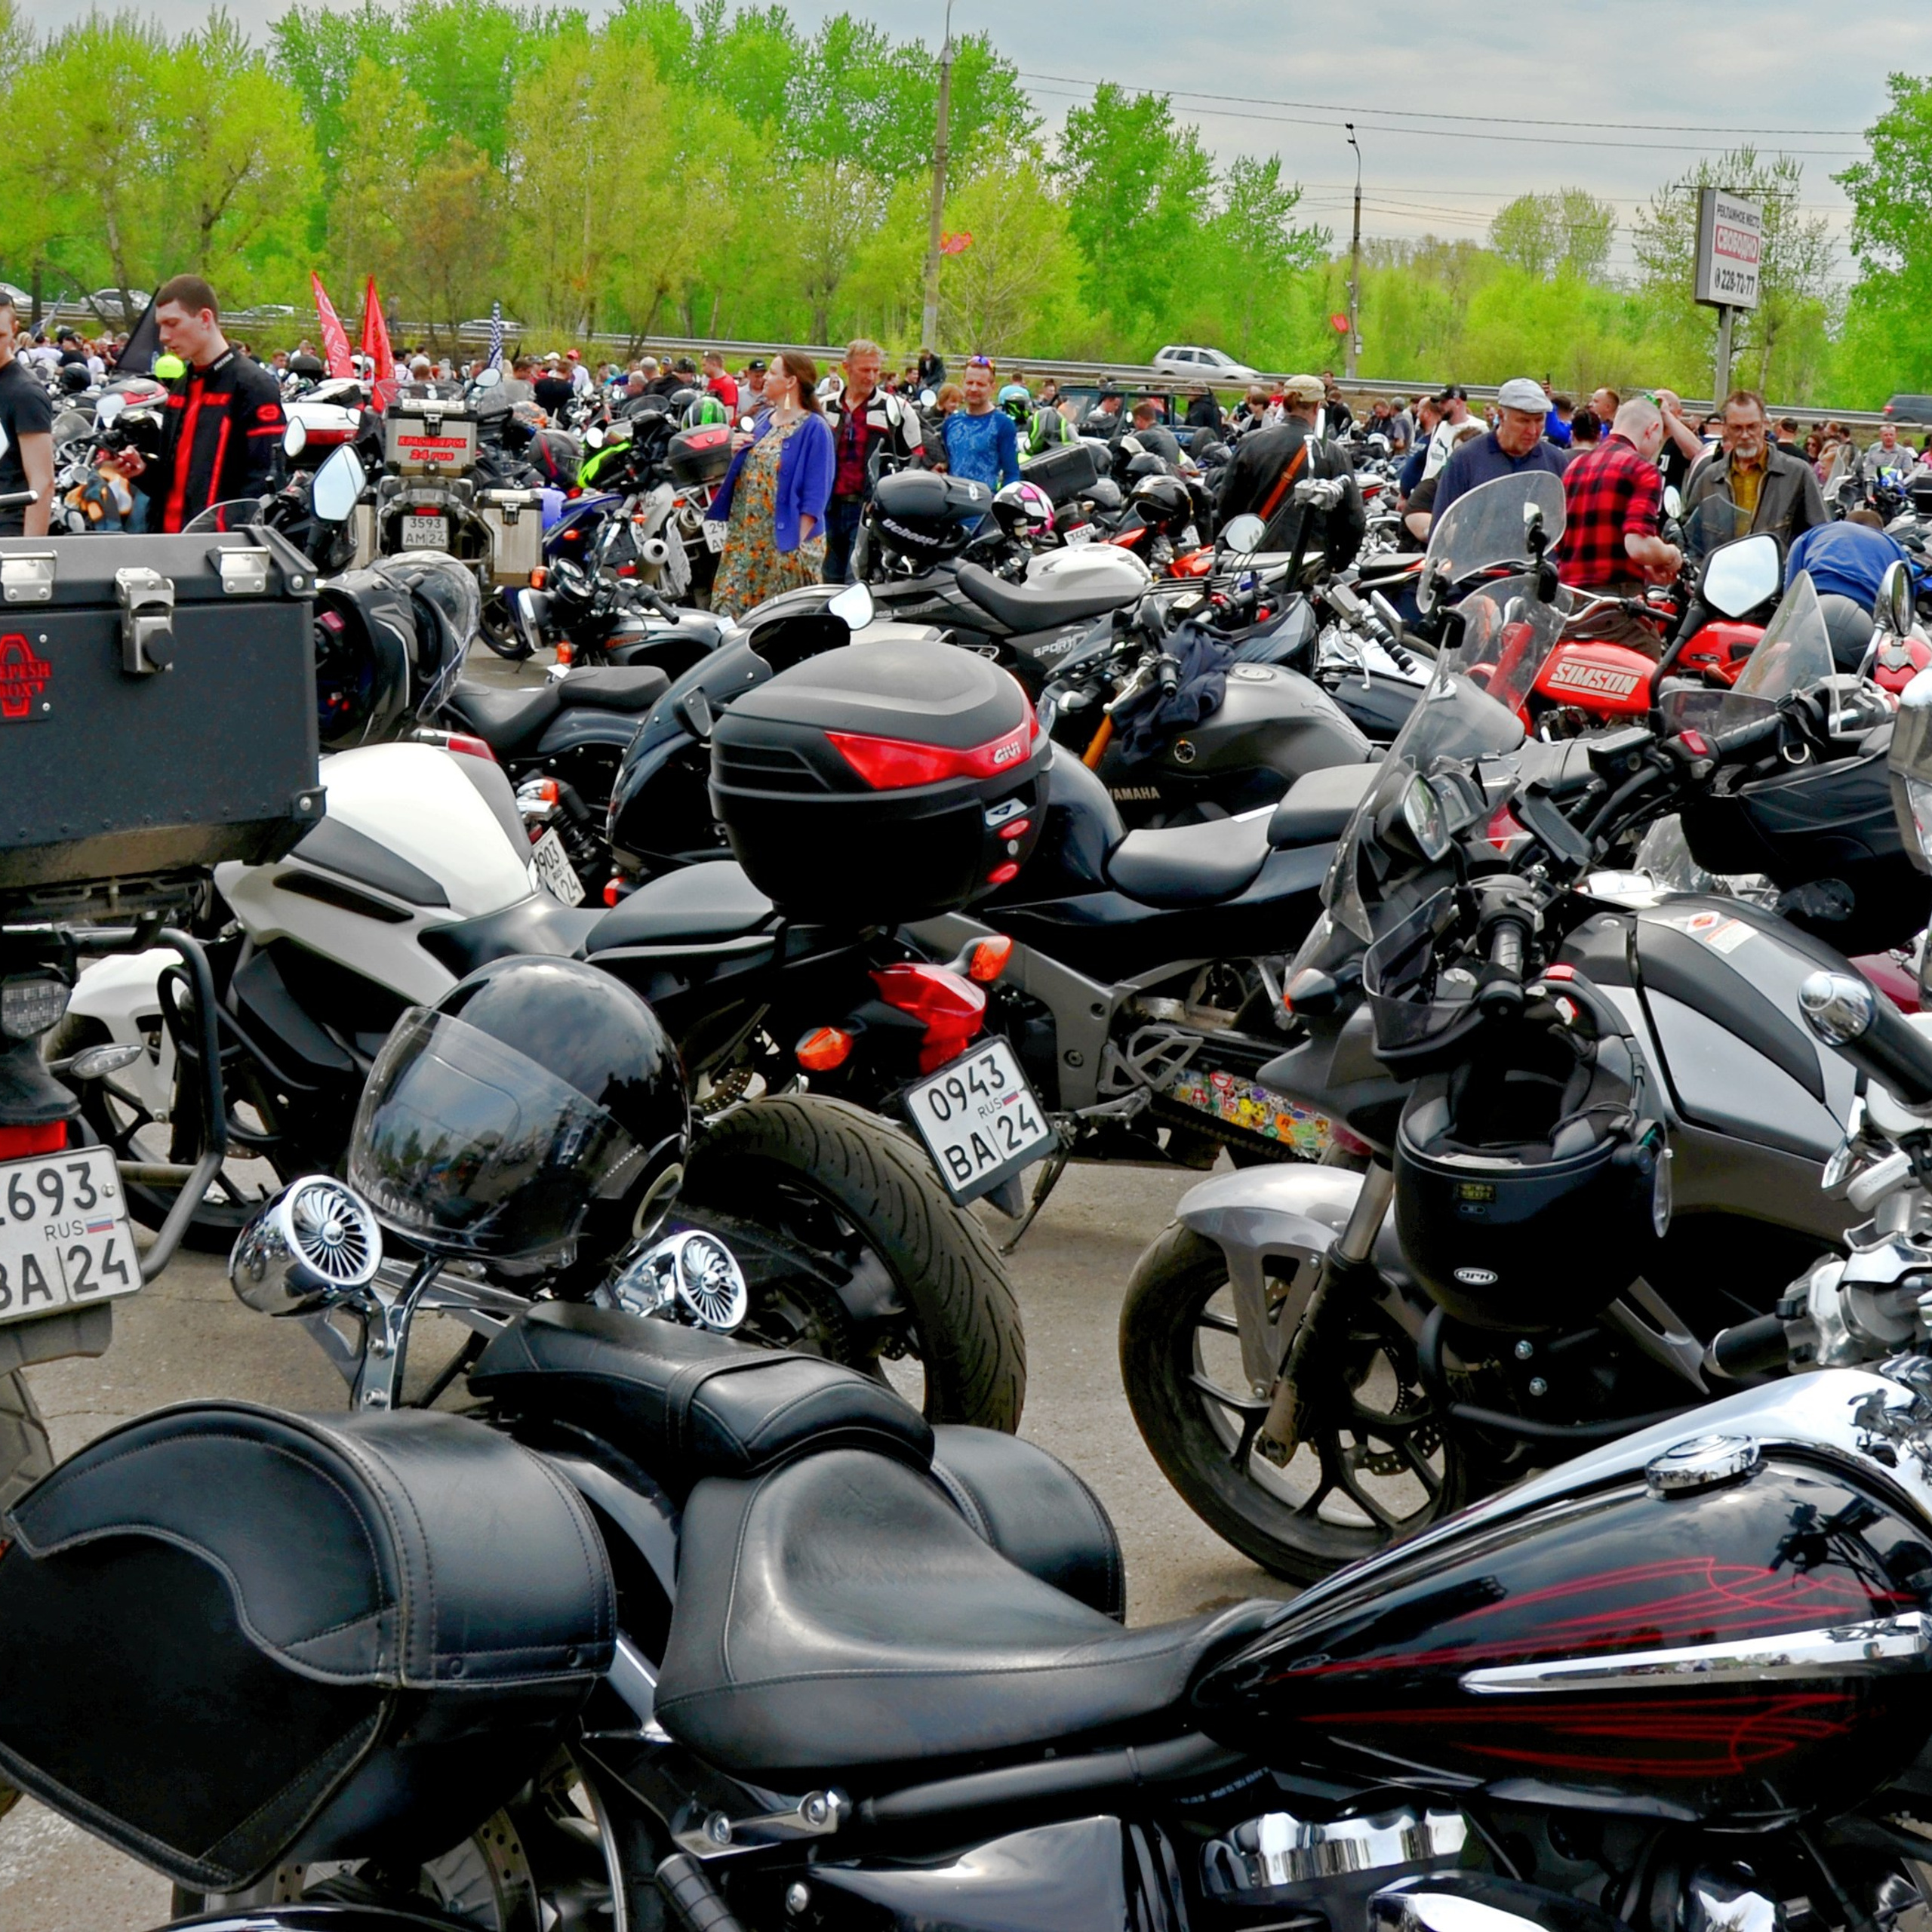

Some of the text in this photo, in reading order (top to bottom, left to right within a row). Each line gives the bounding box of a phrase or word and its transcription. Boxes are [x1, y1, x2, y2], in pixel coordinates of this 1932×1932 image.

[1717, 228, 1758, 260] СВОБОДНО
[398, 435, 467, 448] КРАСНОЯРСК
[410, 449, 429, 460] 24
[410, 518, 441, 529] 3593
[405, 533, 445, 544] AM 24
[1033, 638, 1075, 657] SPORT
[1550, 662, 1640, 695] SIMSON
[994, 741, 1021, 764] GIVI
[560, 872, 582, 903] 24
[928, 1054, 1005, 1121] 0943
[977, 1097, 1003, 1119] RUS
[944, 1103, 1040, 1182] BA 24
[0, 1161, 97, 1226] 693
[44, 1220, 85, 1241] RUS
[67, 1238, 130, 1294] 24
